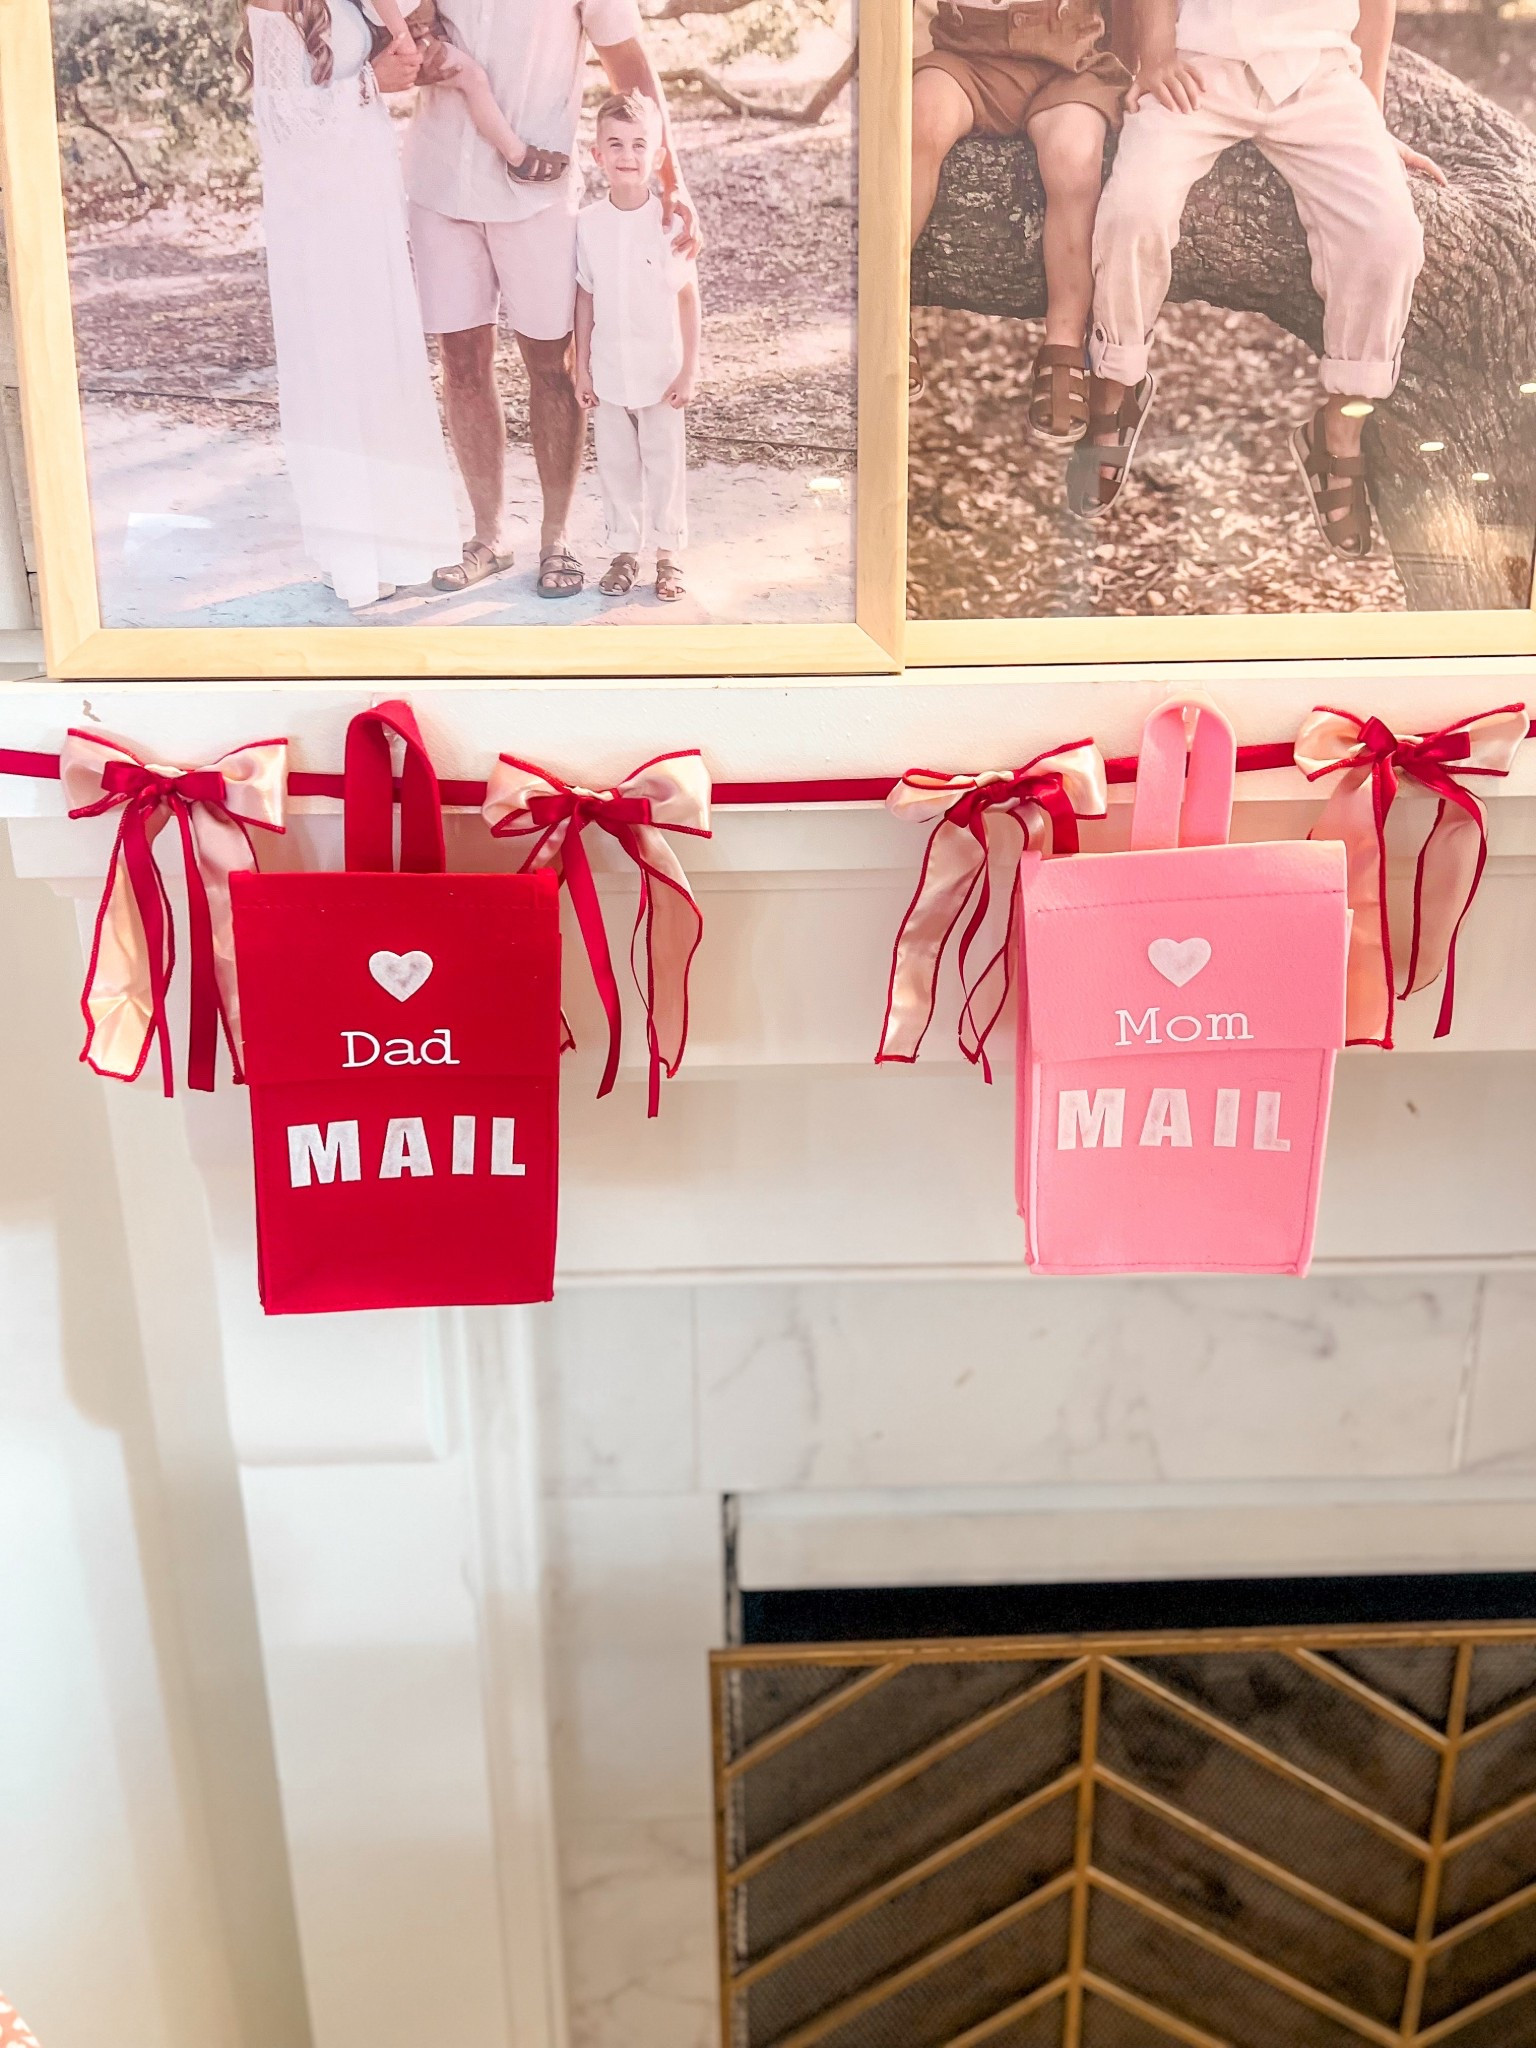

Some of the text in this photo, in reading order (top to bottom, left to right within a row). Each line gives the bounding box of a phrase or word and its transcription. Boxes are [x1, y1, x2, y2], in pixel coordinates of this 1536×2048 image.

[340, 1029, 460, 1068] Dad
[1114, 1007, 1254, 1047] Mom
[1057, 1087, 1291, 1152] MAIL
[287, 1115, 526, 1188] MAIL
